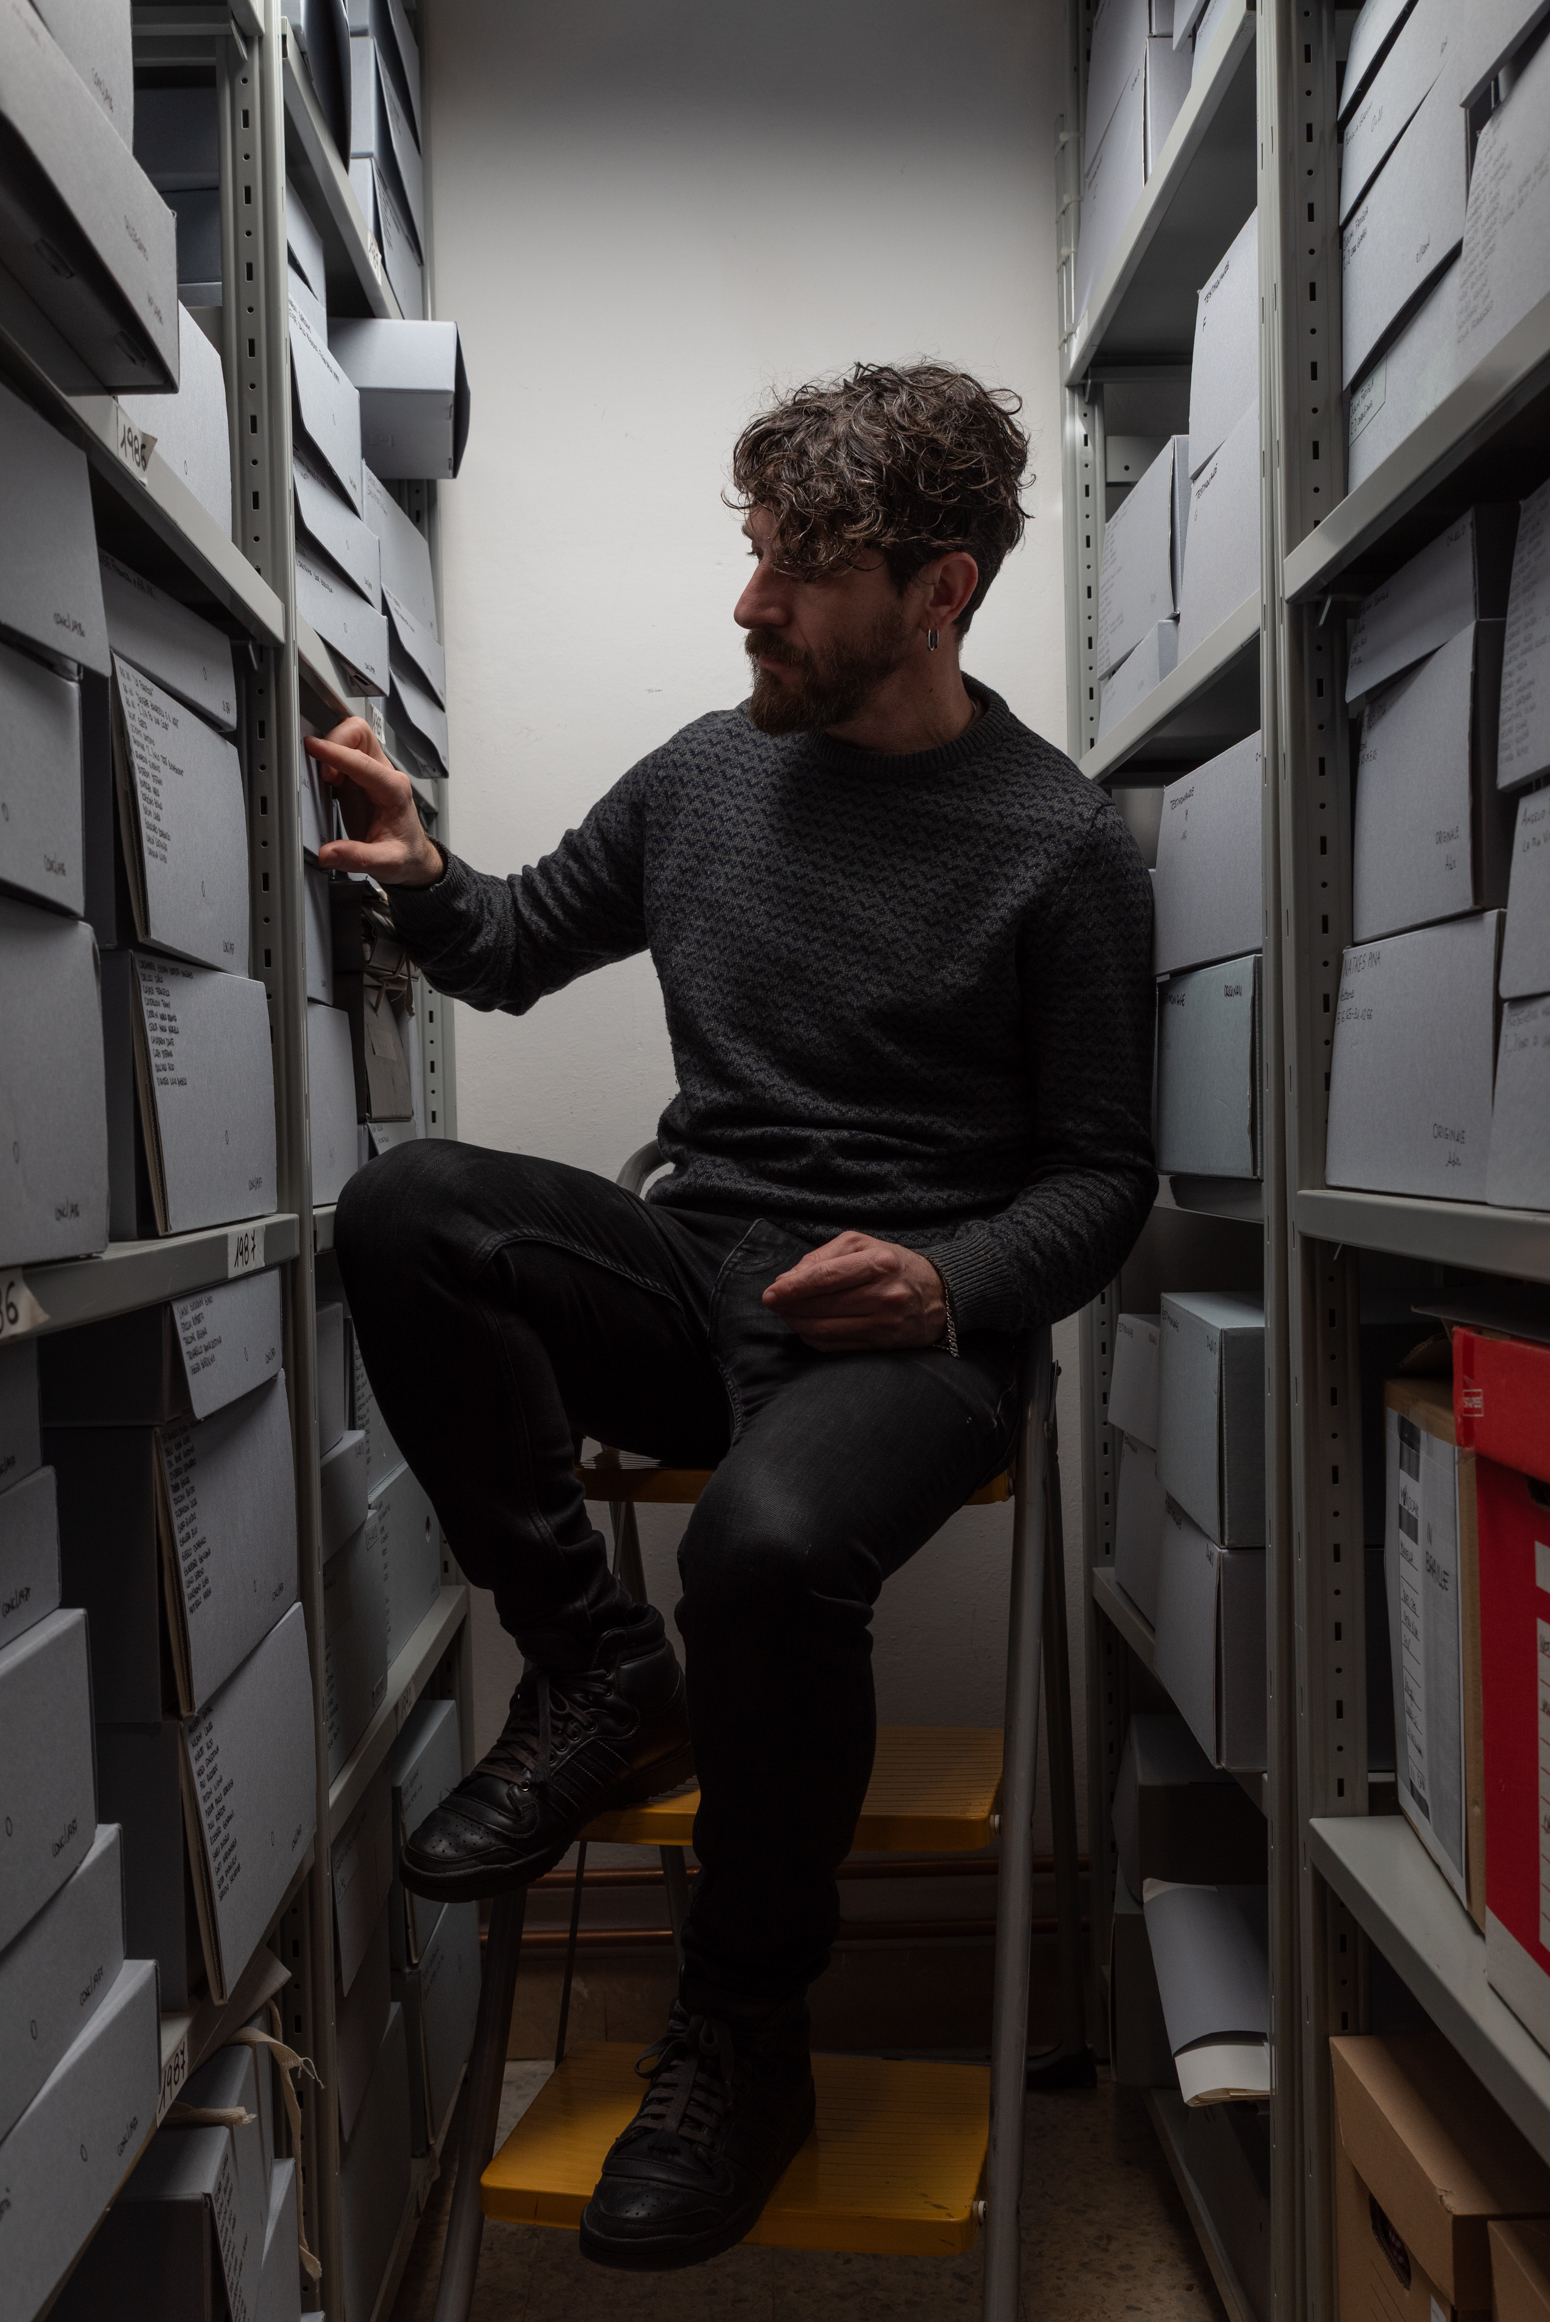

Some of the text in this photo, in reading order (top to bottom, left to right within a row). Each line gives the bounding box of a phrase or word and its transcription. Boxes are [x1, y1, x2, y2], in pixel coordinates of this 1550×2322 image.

[120, 424, 147, 472] 1986
[1433, 1123, 1466, 1145] ORIGINALE
[234, 1232, 257, 1268] 1987
[157, 2041, 188, 2116] 1987
